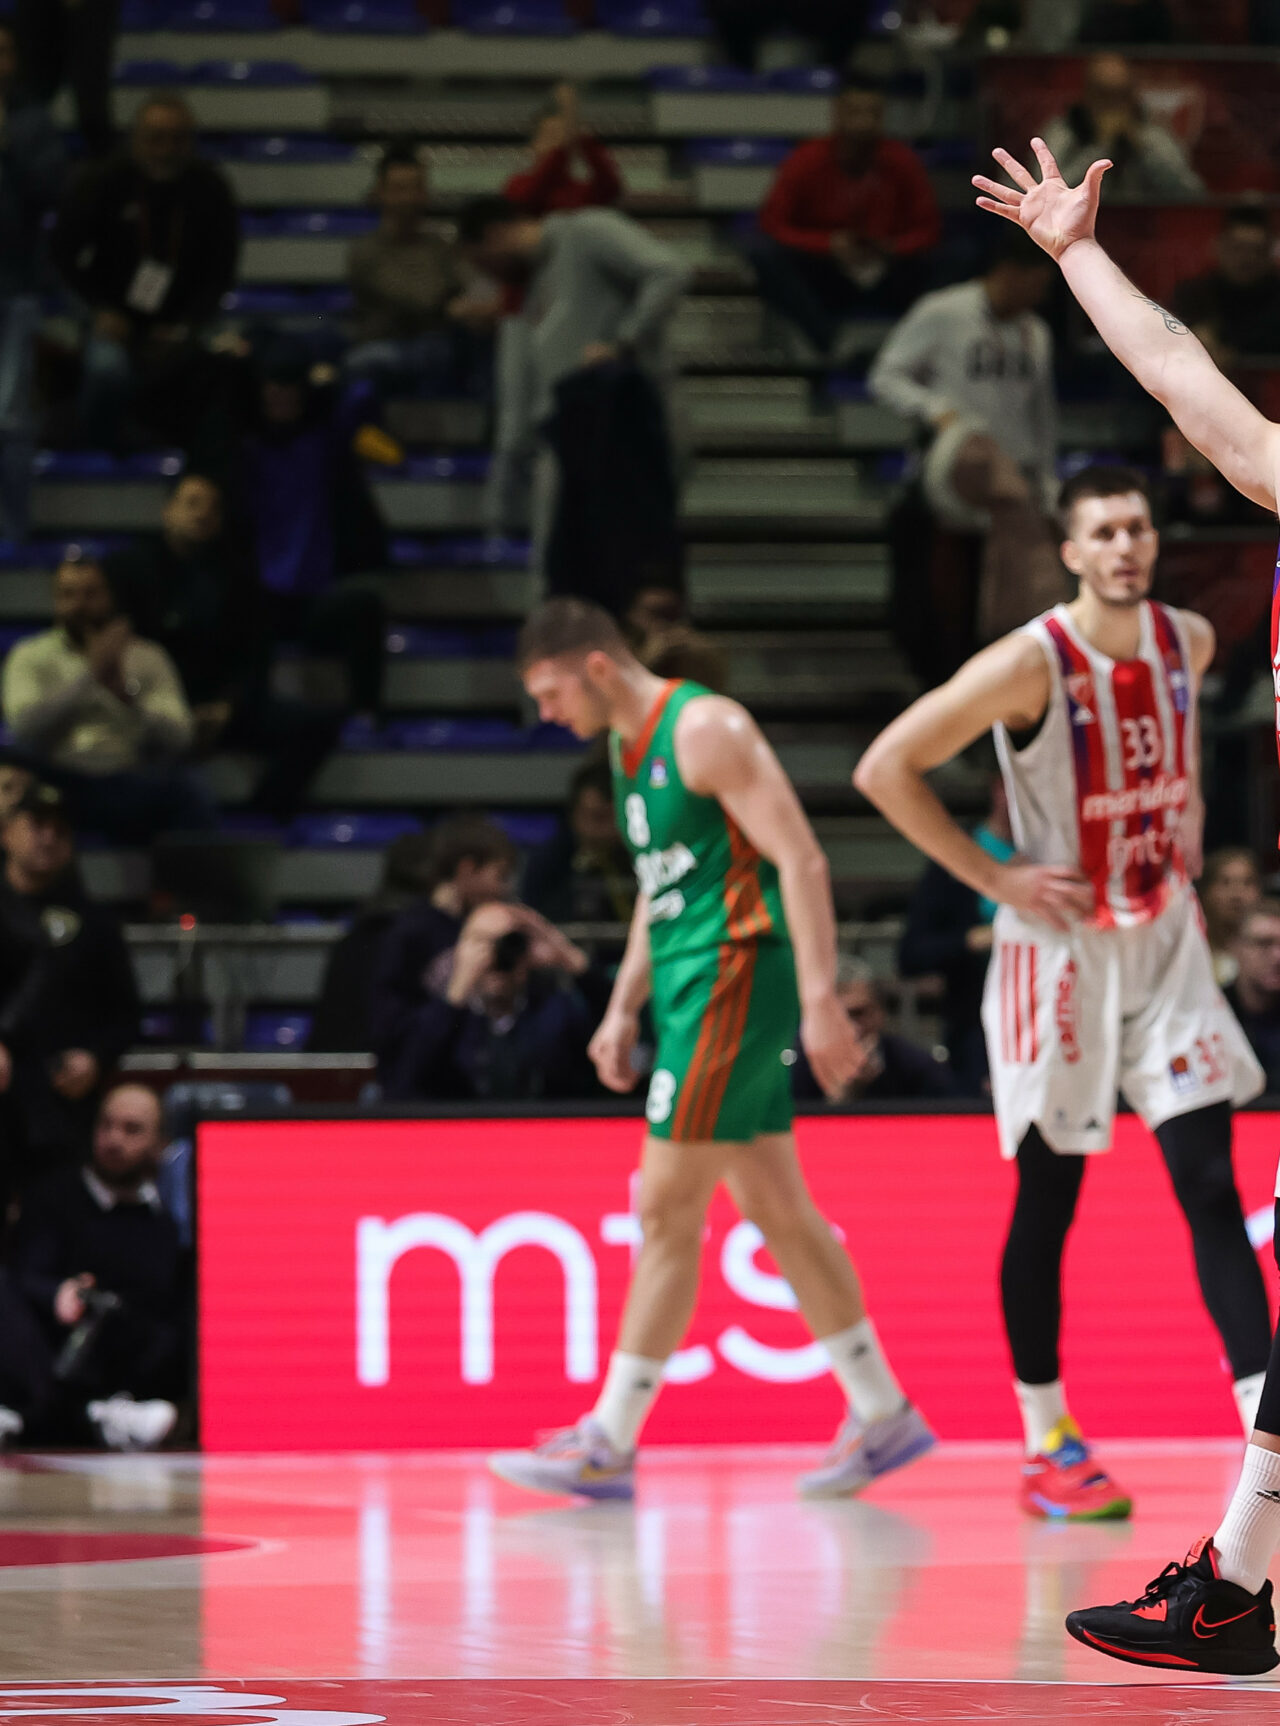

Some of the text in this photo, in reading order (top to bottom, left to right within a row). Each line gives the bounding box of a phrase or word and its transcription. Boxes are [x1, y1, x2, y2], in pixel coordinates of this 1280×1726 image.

[1121, 715, 1163, 770] 33
[625, 792, 651, 848] 8
[645, 1068, 677, 1124] 8
